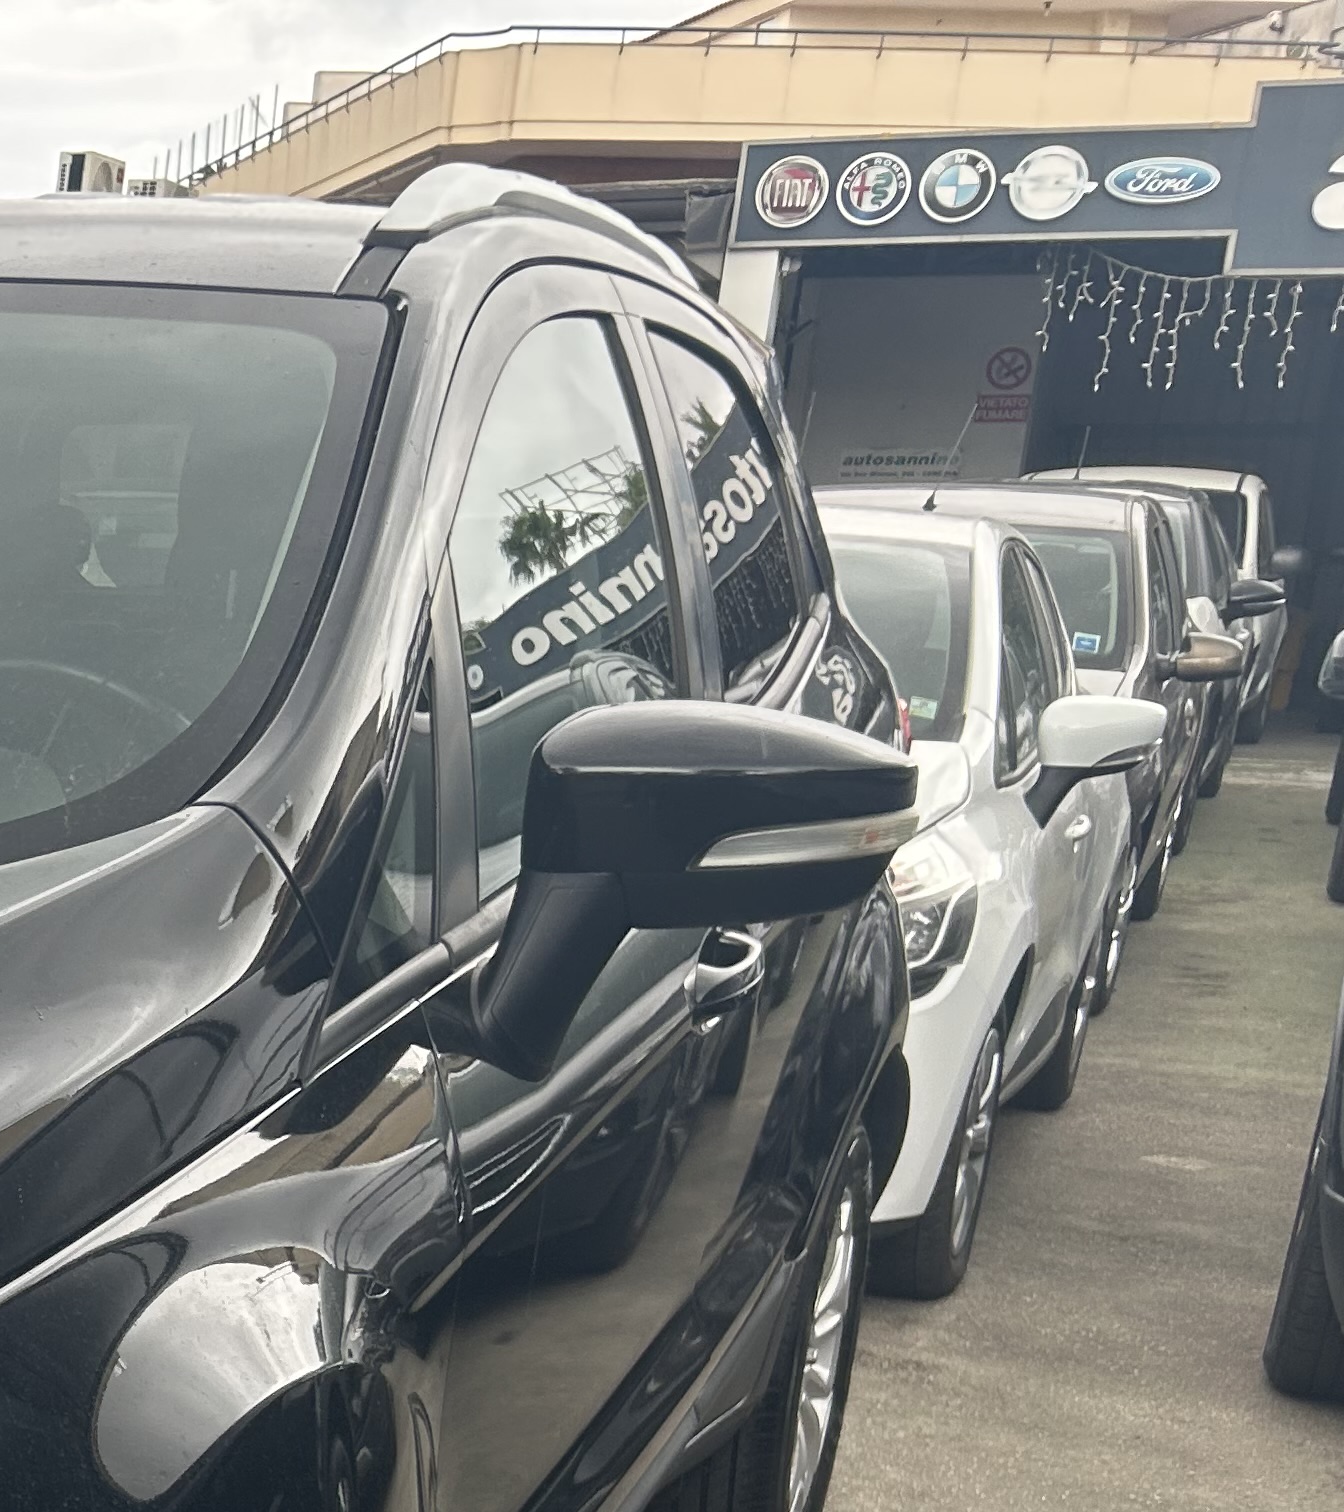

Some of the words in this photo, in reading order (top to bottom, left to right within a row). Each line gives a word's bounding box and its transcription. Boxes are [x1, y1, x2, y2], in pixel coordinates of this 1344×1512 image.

[843, 162, 869, 190] ALFA
[873, 157, 906, 190] ROMEO
[1126, 165, 1199, 194] Ford
[773, 178, 813, 207] FIAT
[979, 396, 1030, 408] VIETATO
[976, 409, 1025, 420] FUMARE
[842, 451, 961, 466] autosannino
